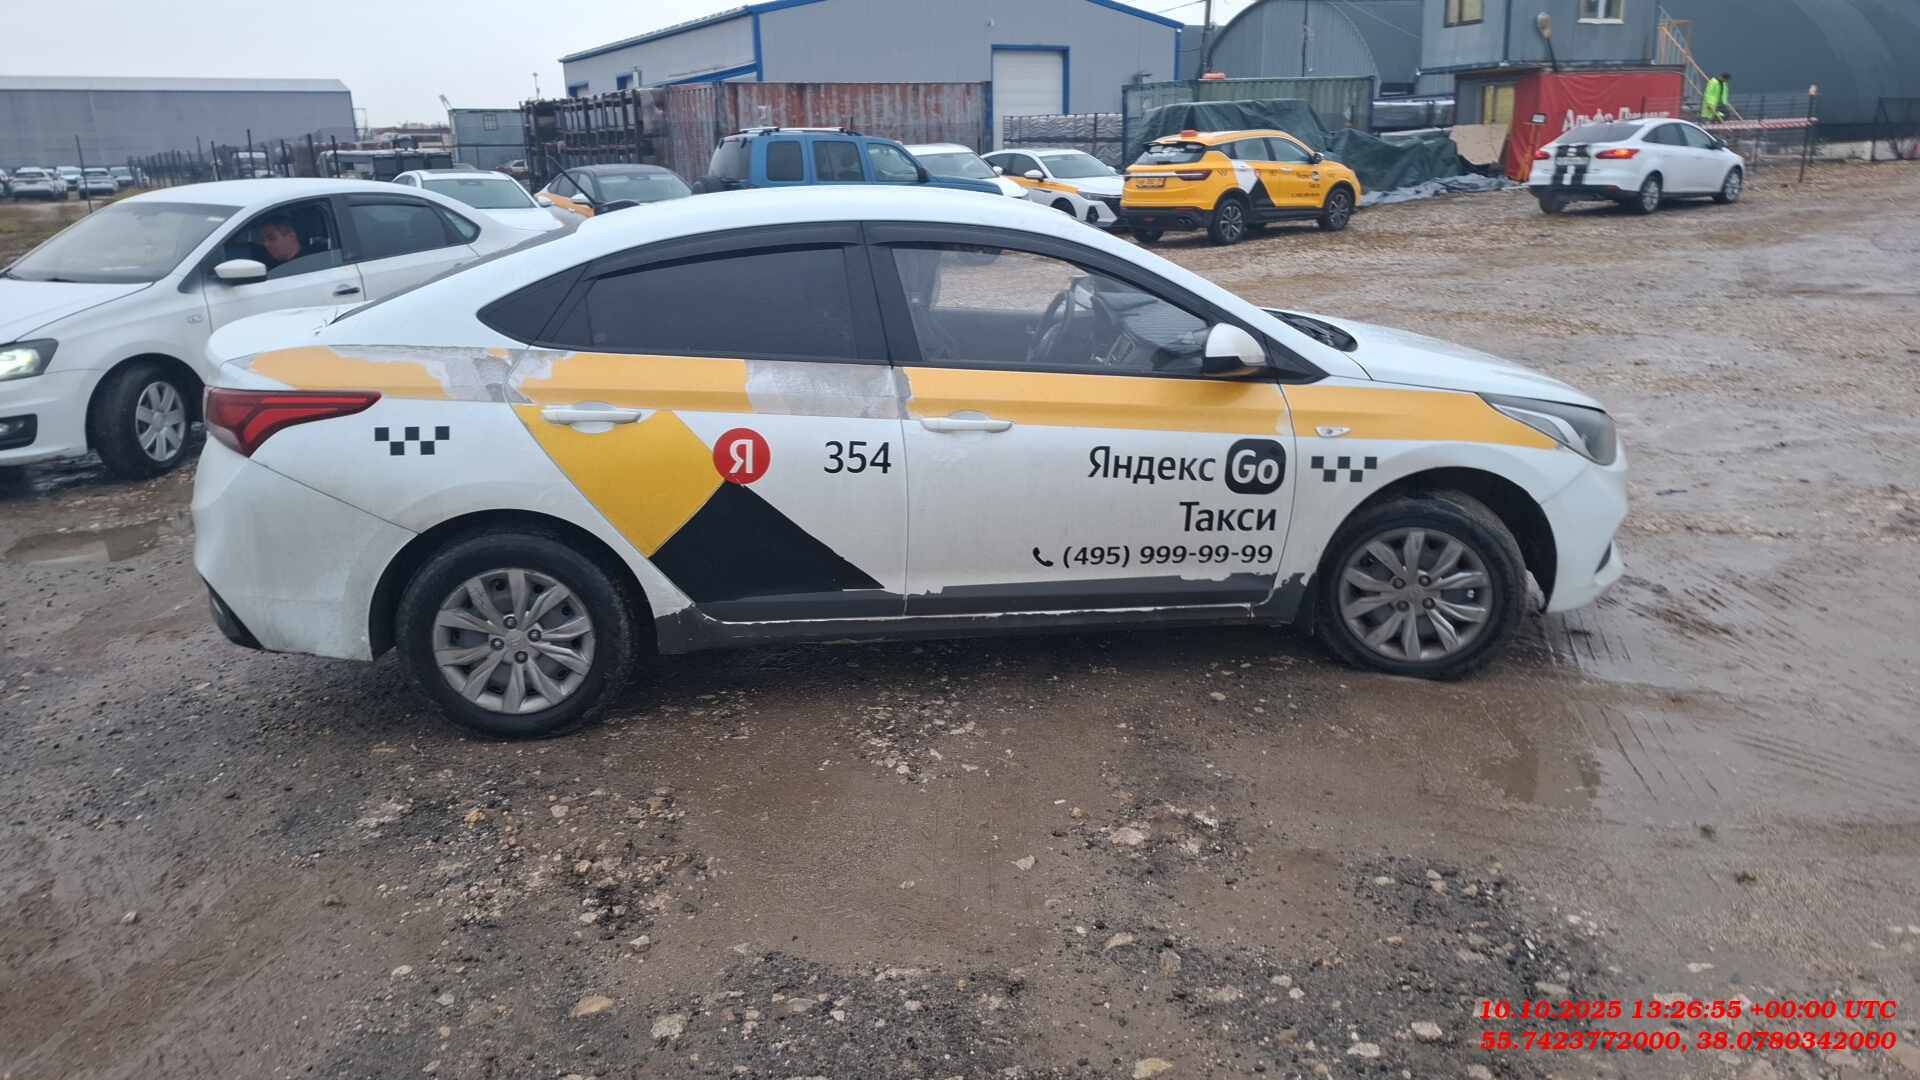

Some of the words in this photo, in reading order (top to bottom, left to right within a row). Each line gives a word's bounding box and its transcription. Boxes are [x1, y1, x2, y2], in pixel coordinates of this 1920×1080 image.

[729, 438, 754, 474] Я
[823, 440, 892, 474] 354
[1088, 445, 1216, 484] Яндекс
[1231, 449, 1280, 485] Go
[1179, 501, 1277, 532] Такси
[1062, 545, 1131, 569] (495)
[1139, 544, 1274, 565] 999-99-99
